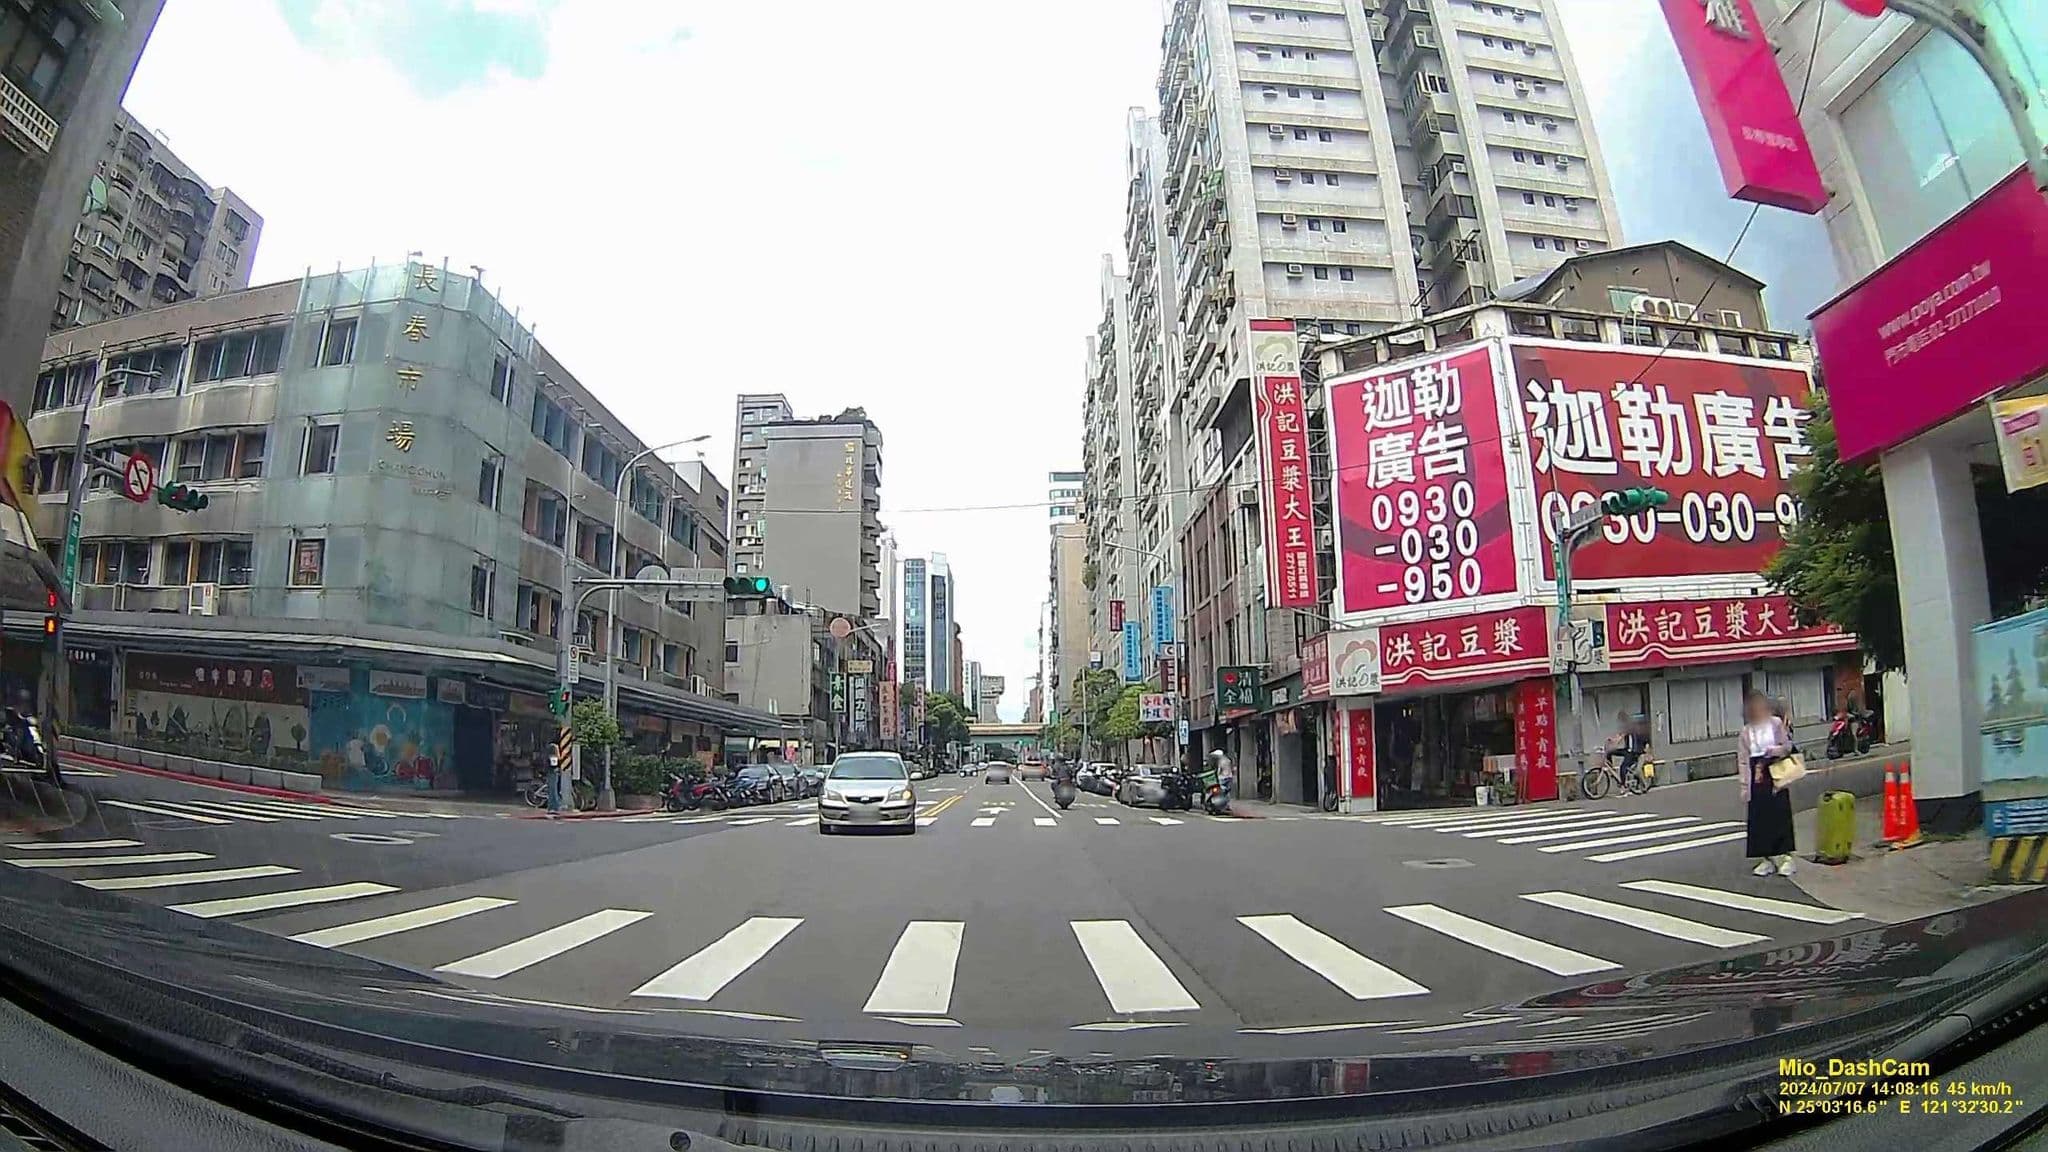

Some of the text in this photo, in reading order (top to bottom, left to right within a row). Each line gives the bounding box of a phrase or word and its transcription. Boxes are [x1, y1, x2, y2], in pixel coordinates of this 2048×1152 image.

[386, 264, 439, 453] 長春市場
[1361, 361, 1462, 433] 迦勒
[1525, 378, 1813, 480] 迦勒廣告
[1273, 382, 1307, 548] 洪記豆漿大王
[1367, 422, 1469, 489] 廣告
[1372, 481, 1475, 532] 0930
[1375, 519, 1479, 565] -030
[1377, 558, 1482, 603] -950
[1386, 618, 1524, 667] 洪記豆漿
